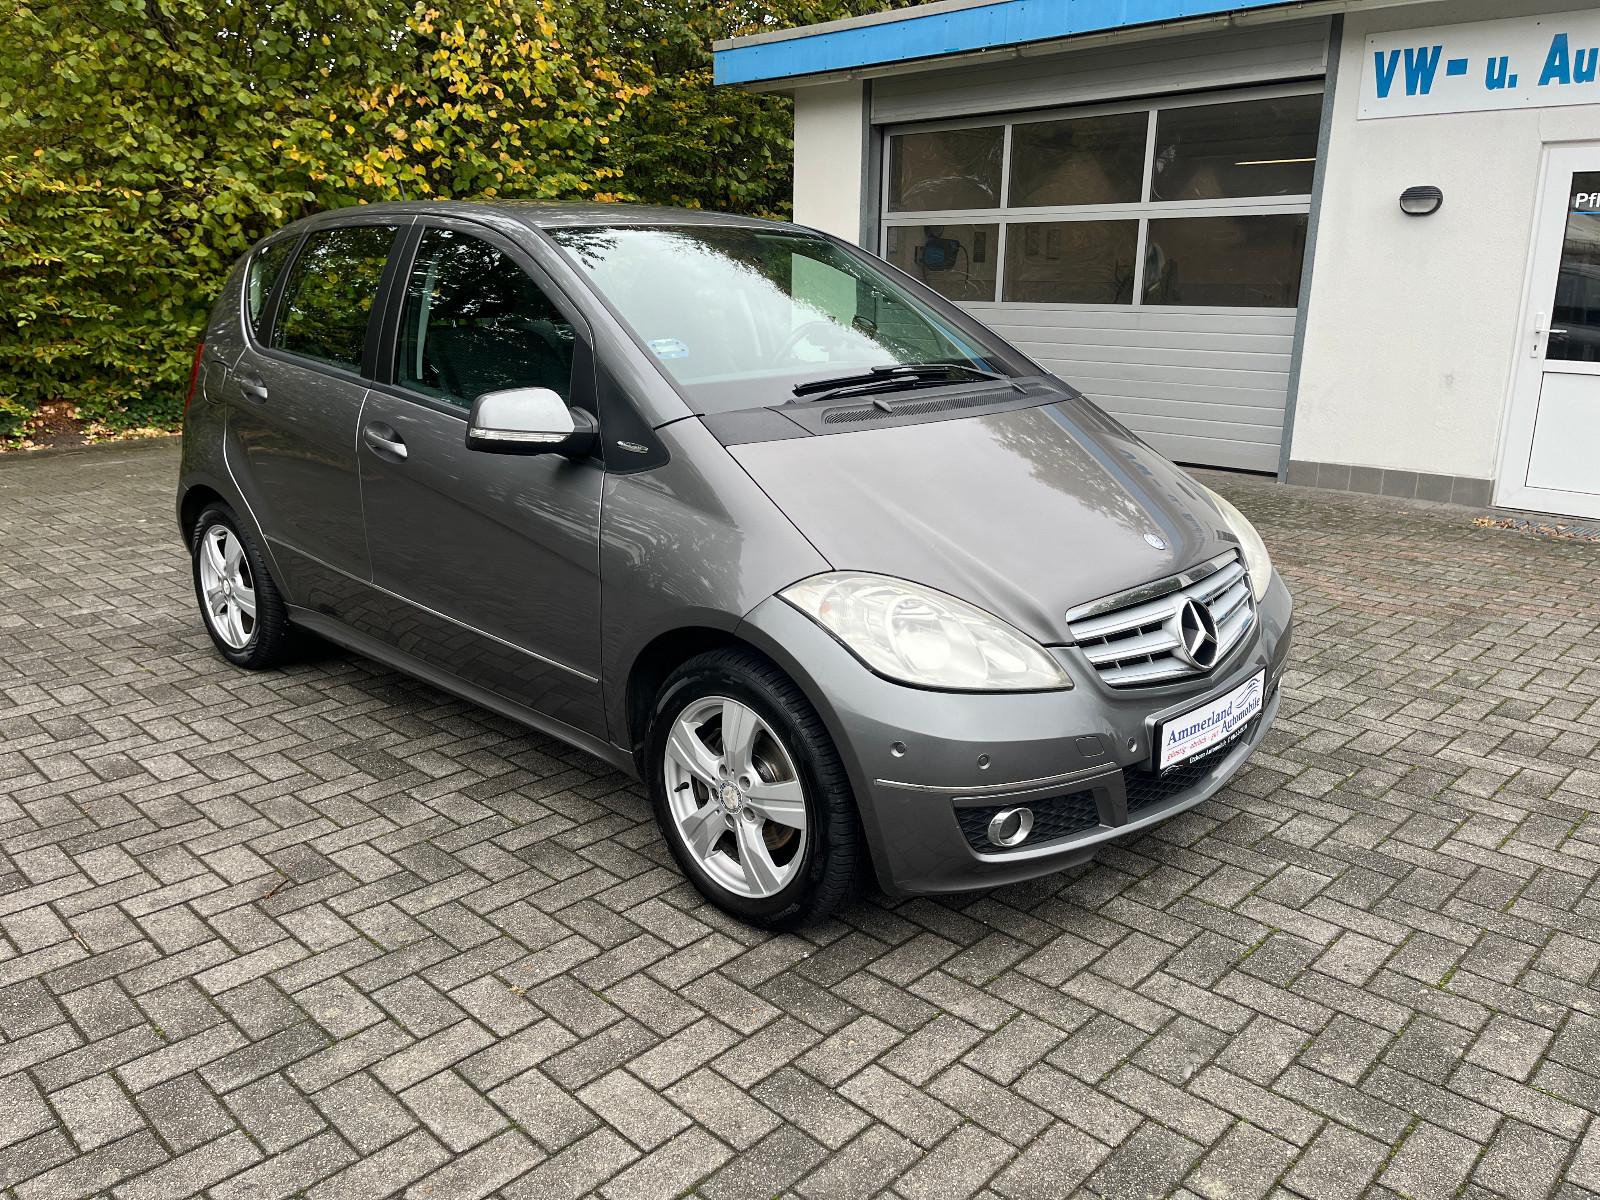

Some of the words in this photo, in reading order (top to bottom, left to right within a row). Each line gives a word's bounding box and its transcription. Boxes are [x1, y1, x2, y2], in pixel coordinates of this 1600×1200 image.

[1374, 45, 1469, 99] VW-
[1485, 56, 1518, 91] u.
[1167, 700, 1233, 747] Ammerland
[1220, 697, 1261, 734] Automobile
